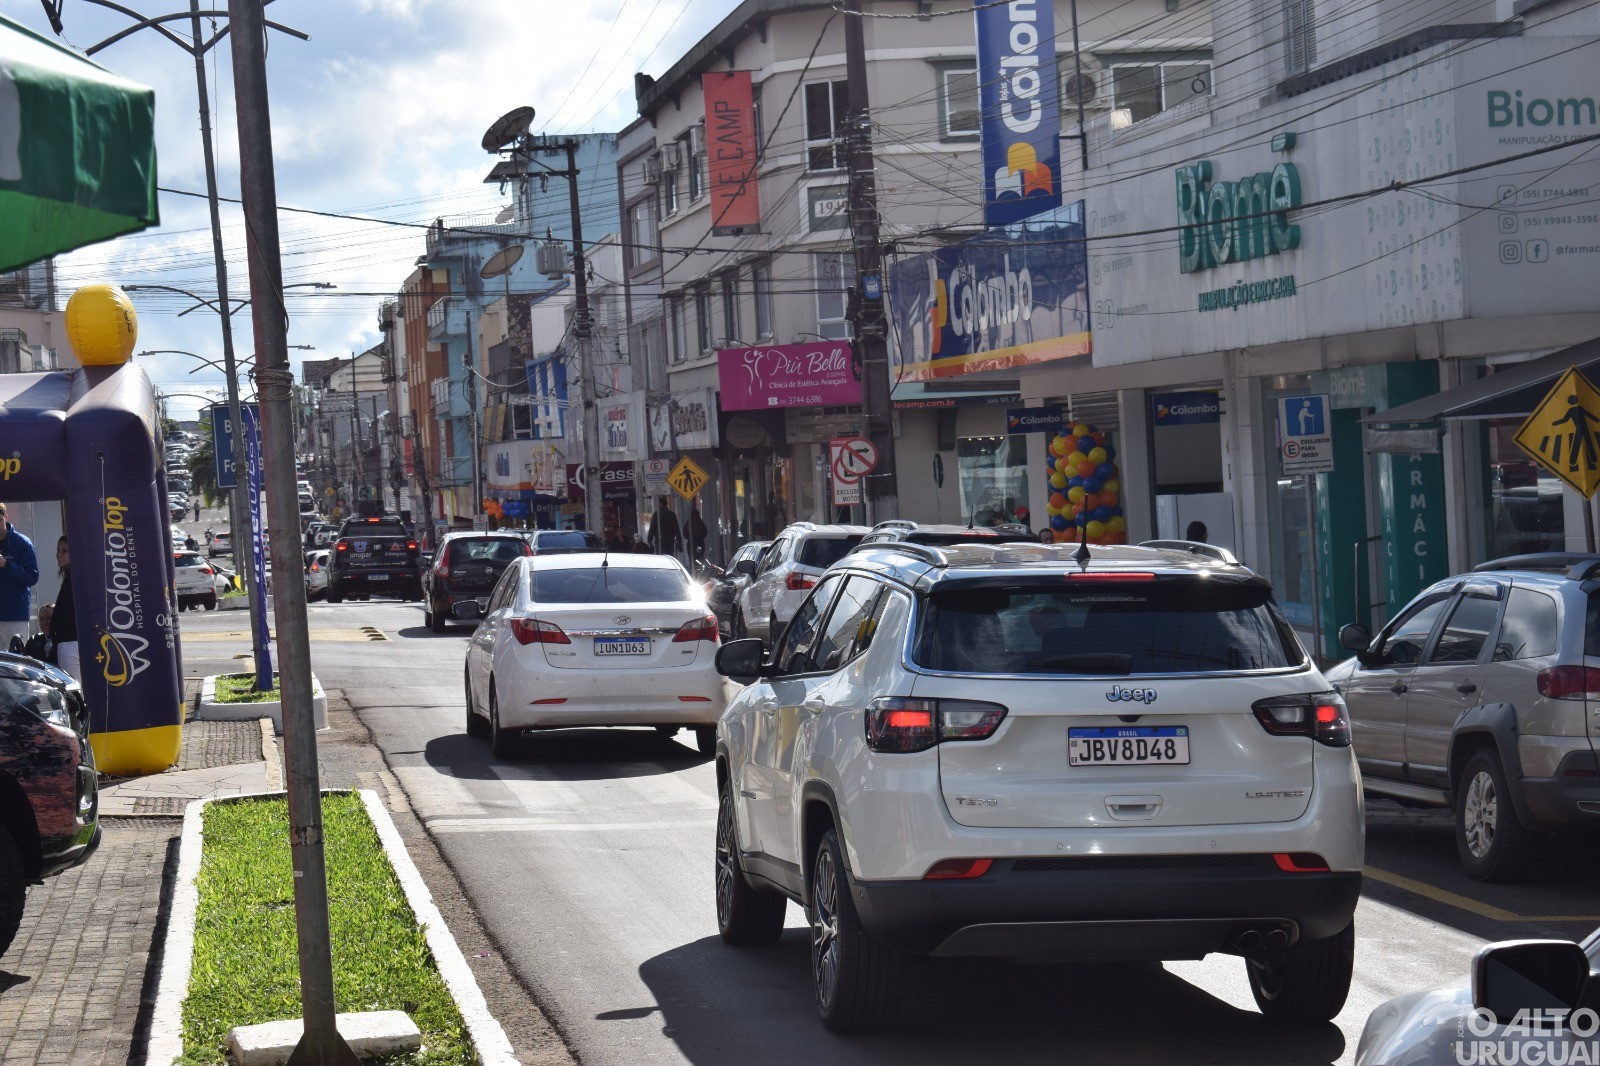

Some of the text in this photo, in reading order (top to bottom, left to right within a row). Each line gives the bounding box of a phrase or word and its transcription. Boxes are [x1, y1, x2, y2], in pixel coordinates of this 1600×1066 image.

[1487, 89, 1600, 128] Biom
[714, 101, 743, 160] CAMP
[1499, 134, 1561, 146] MANIPULAÇÃO
[1523, 188, 1589, 198] (55) 3744-1861
[1524, 214, 1598, 227] (55) 99943-3596
[949, 253, 1033, 337] Colombo
[806, 348, 847, 375] Bella
[797, 379, 819, 388] Estética
[893, 398, 956, 410] lecamp.com.br
[1170, 403, 1218, 415] Colombo
[1020, 415, 1060, 425] Colombo
[1300, 437, 1330, 445] EXCLUSIVO
[104, 496, 135, 630] OdontoTop
[126, 525, 144, 629] HOSPITAL DO DENTE
[599, 642, 645, 654] IUN1D63
[1105, 684, 1158, 705] Jeep
[1079, 738, 1177, 762] JBV8D48
